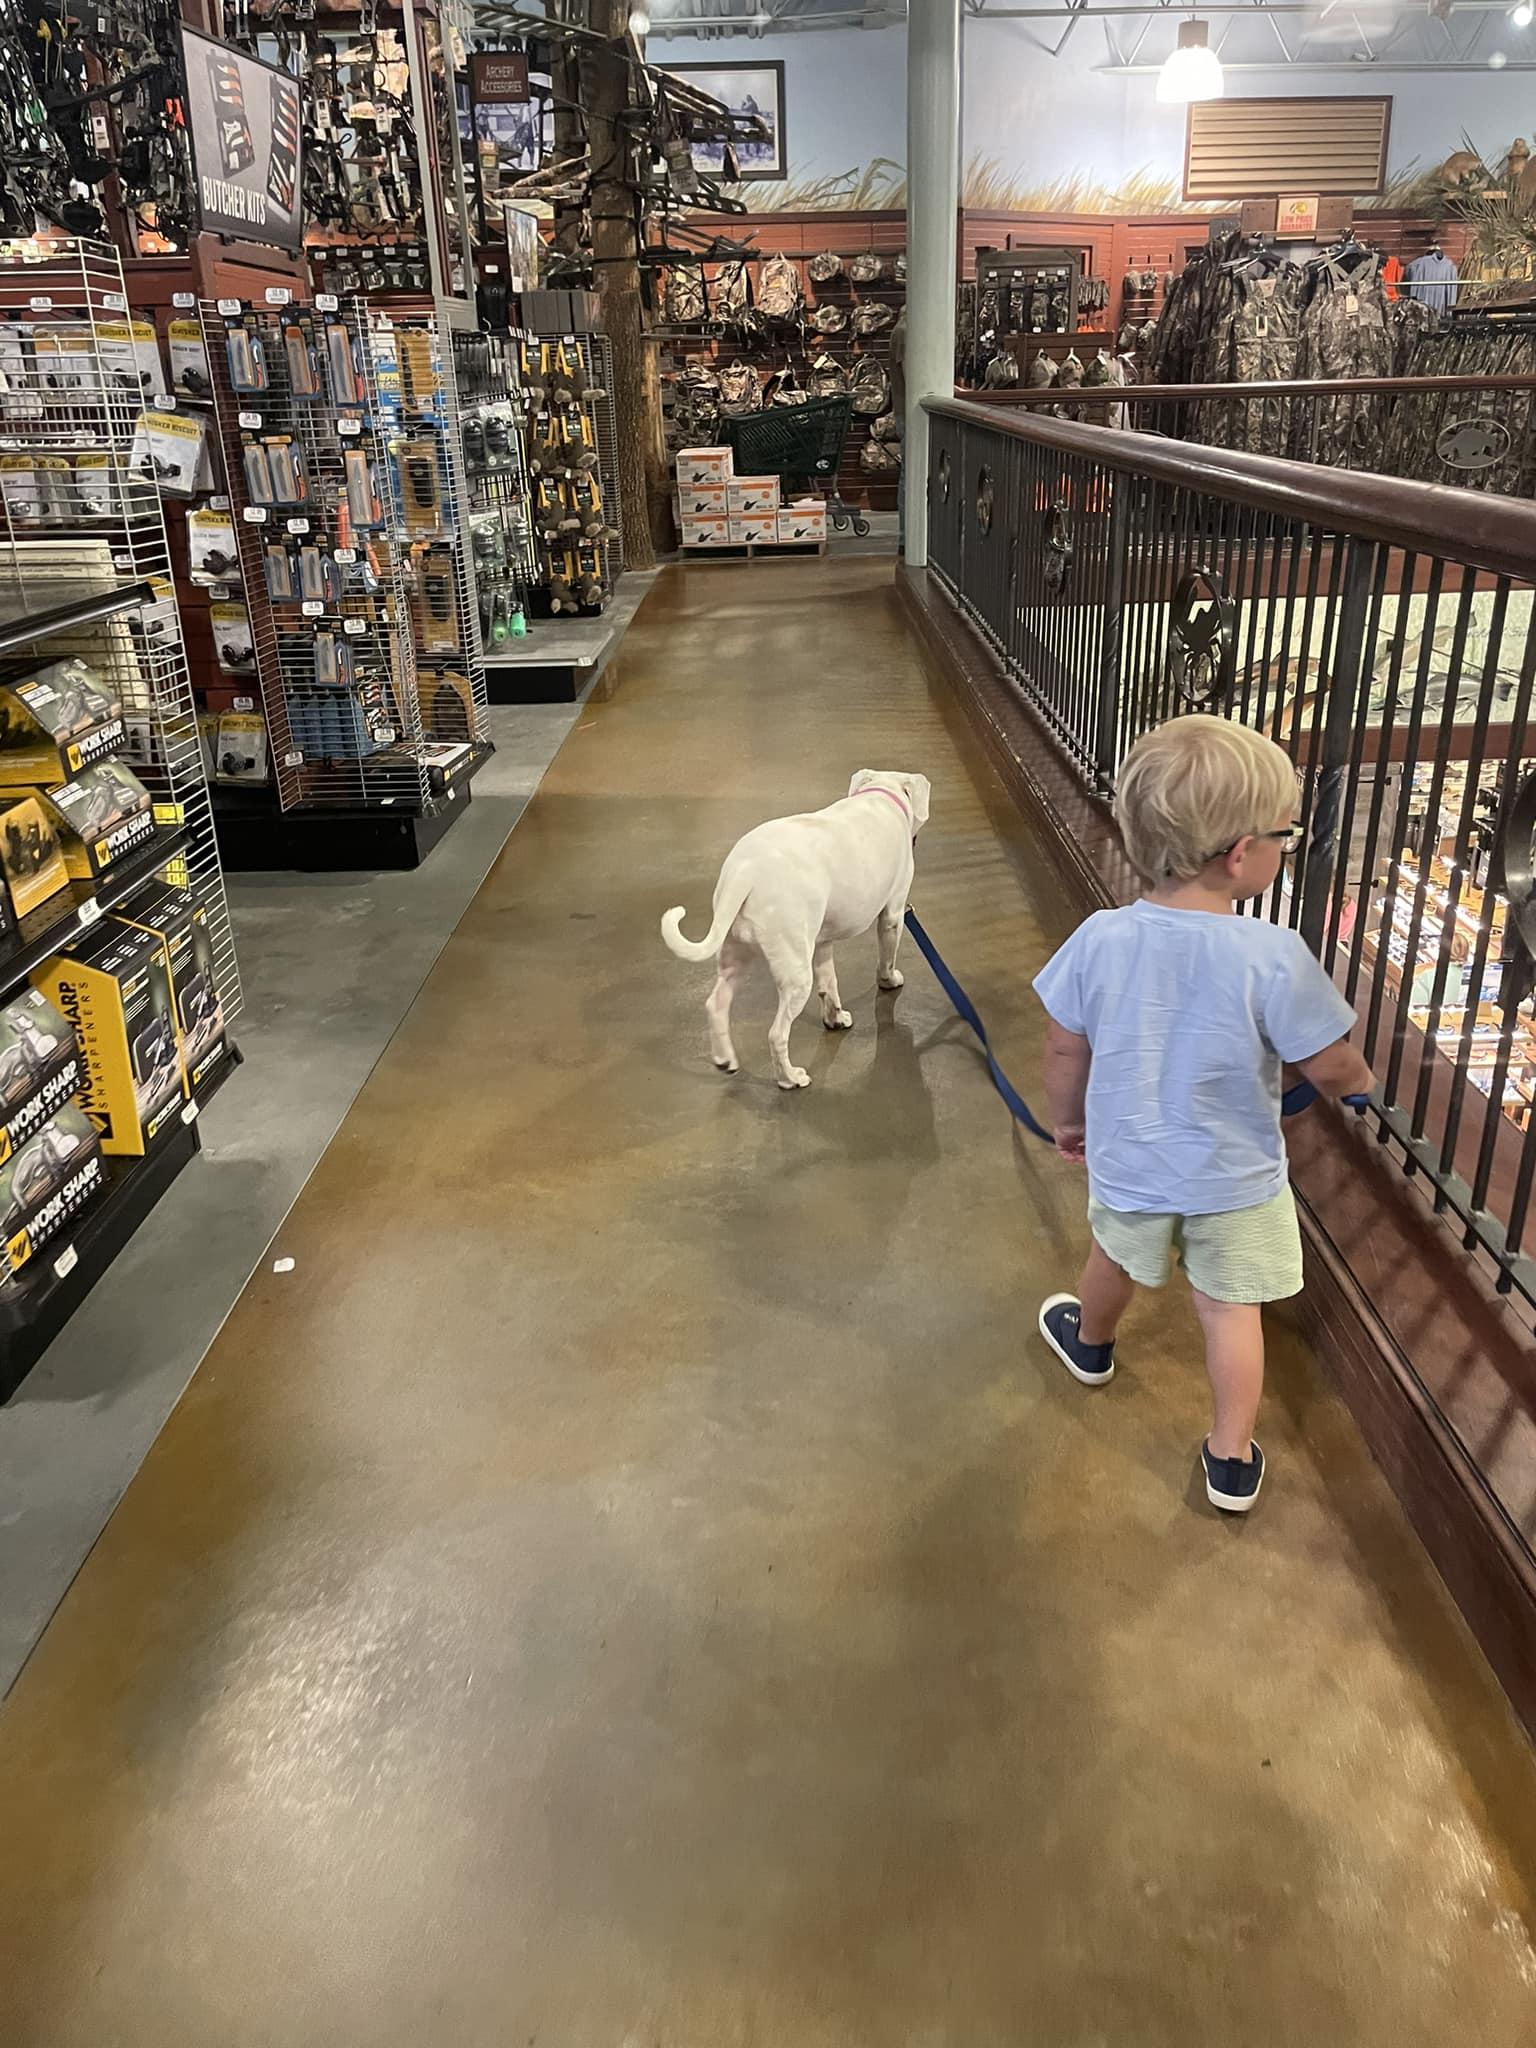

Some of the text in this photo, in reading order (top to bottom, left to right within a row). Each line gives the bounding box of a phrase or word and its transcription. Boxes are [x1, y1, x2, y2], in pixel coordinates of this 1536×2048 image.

[480, 80, 522, 94] ACCESSORIES
[486, 64, 515, 78] ARCHERY
[202, 175, 266, 225] BUTCHER KITS
[79, 719, 122, 755] WORK SHARP
[107, 811, 152, 851] WORK SHARP
[79, 981, 108, 1109] SHARPENERS
[6, 1060, 78, 1138] WORK SHARP
[11, 1076, 81, 1151] SHARPENERS
[26, 1157, 99, 1238] WORK SHARP
[31, 1174, 102, 1252] SHARPENERS
